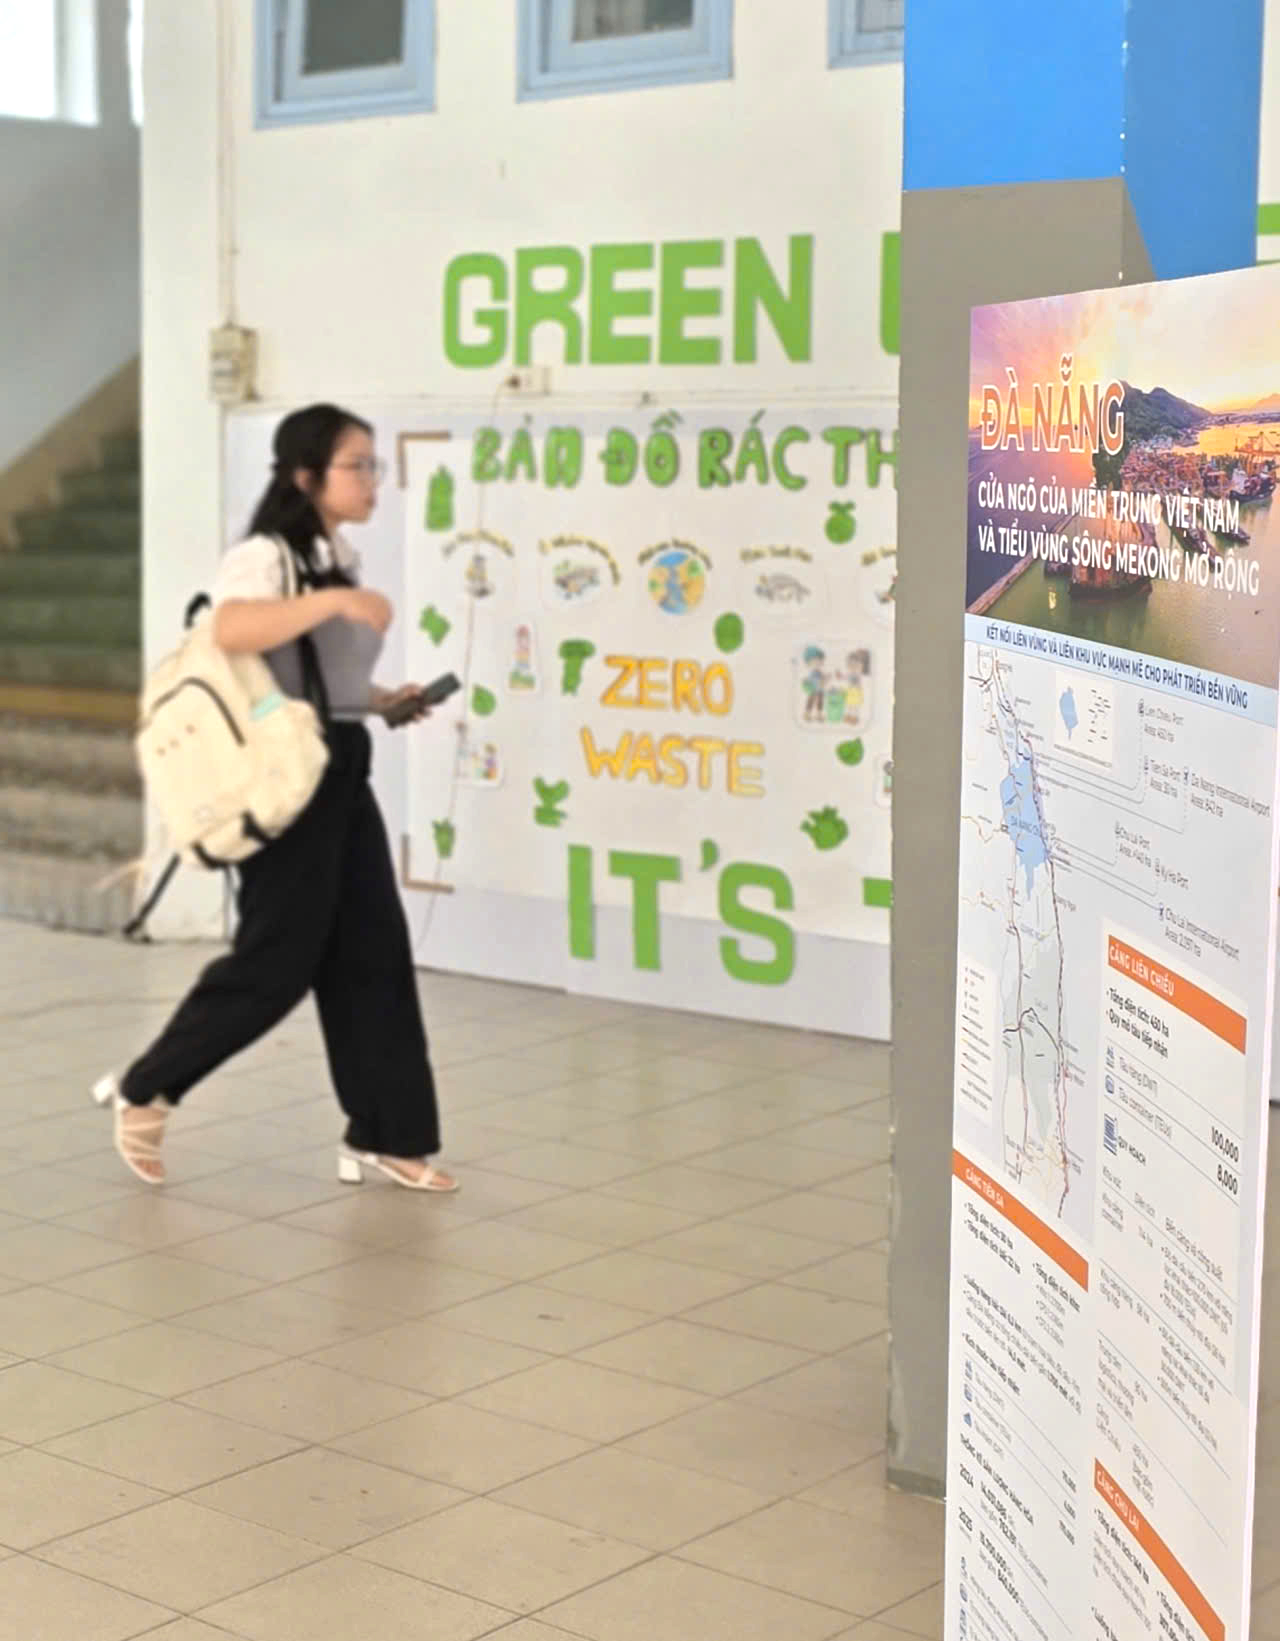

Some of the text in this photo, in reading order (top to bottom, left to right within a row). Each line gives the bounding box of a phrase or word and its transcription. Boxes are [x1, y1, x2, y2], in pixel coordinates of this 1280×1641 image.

[442, 233, 814, 370] GREEN
[980, 352, 1125, 455] ĐÀ NẴNG
[472, 412, 583, 489] BẢN
[600, 409, 680, 487] ĐỒ
[697, 409, 811, 491] RÁC
[978, 471, 1240, 537] CỬA NGÕ CỦA MIỀN TRUNG VIỆT NAM
[978, 518, 1260, 600] VÀ TIỂU VÙNG SÔNG MEKONG MỞ RỘNG
[600, 653, 735, 718] ZERO
[1145, 664, 1161, 683] CHO
[579, 725, 766, 798] WASTE
[566, 838, 796, 987] IT'S
